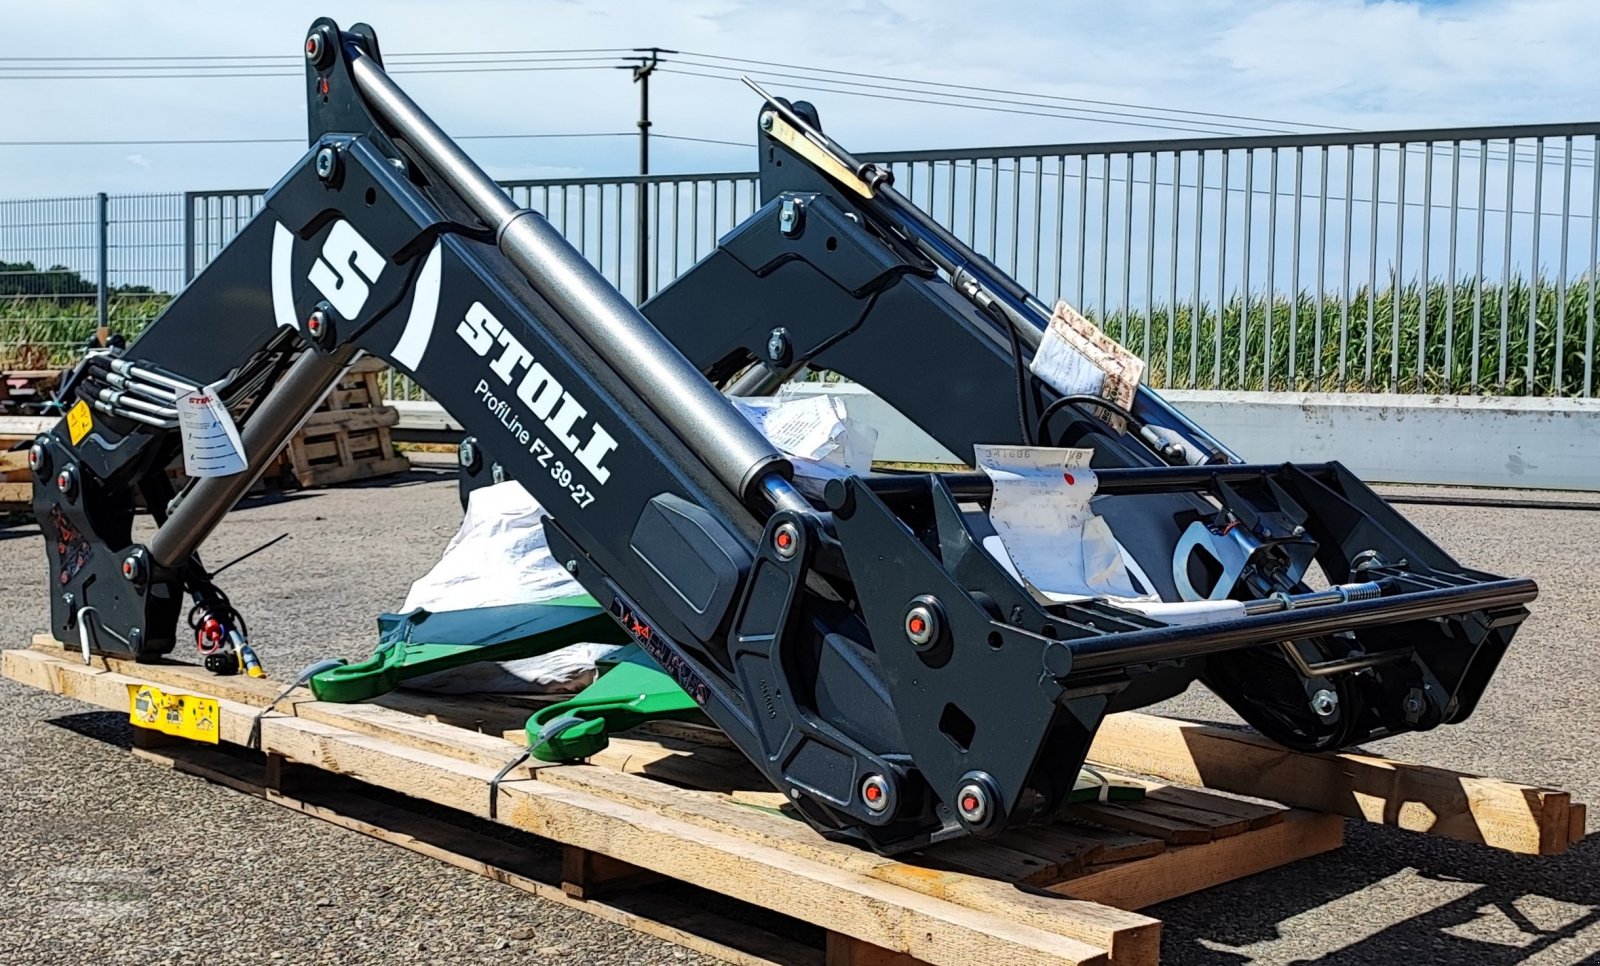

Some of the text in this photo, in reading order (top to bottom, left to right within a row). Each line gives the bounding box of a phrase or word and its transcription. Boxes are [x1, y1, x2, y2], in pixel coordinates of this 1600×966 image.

[455, 301, 619, 486] STOLL
[474, 379, 596, 510] ProfiLine FZ 39-27
